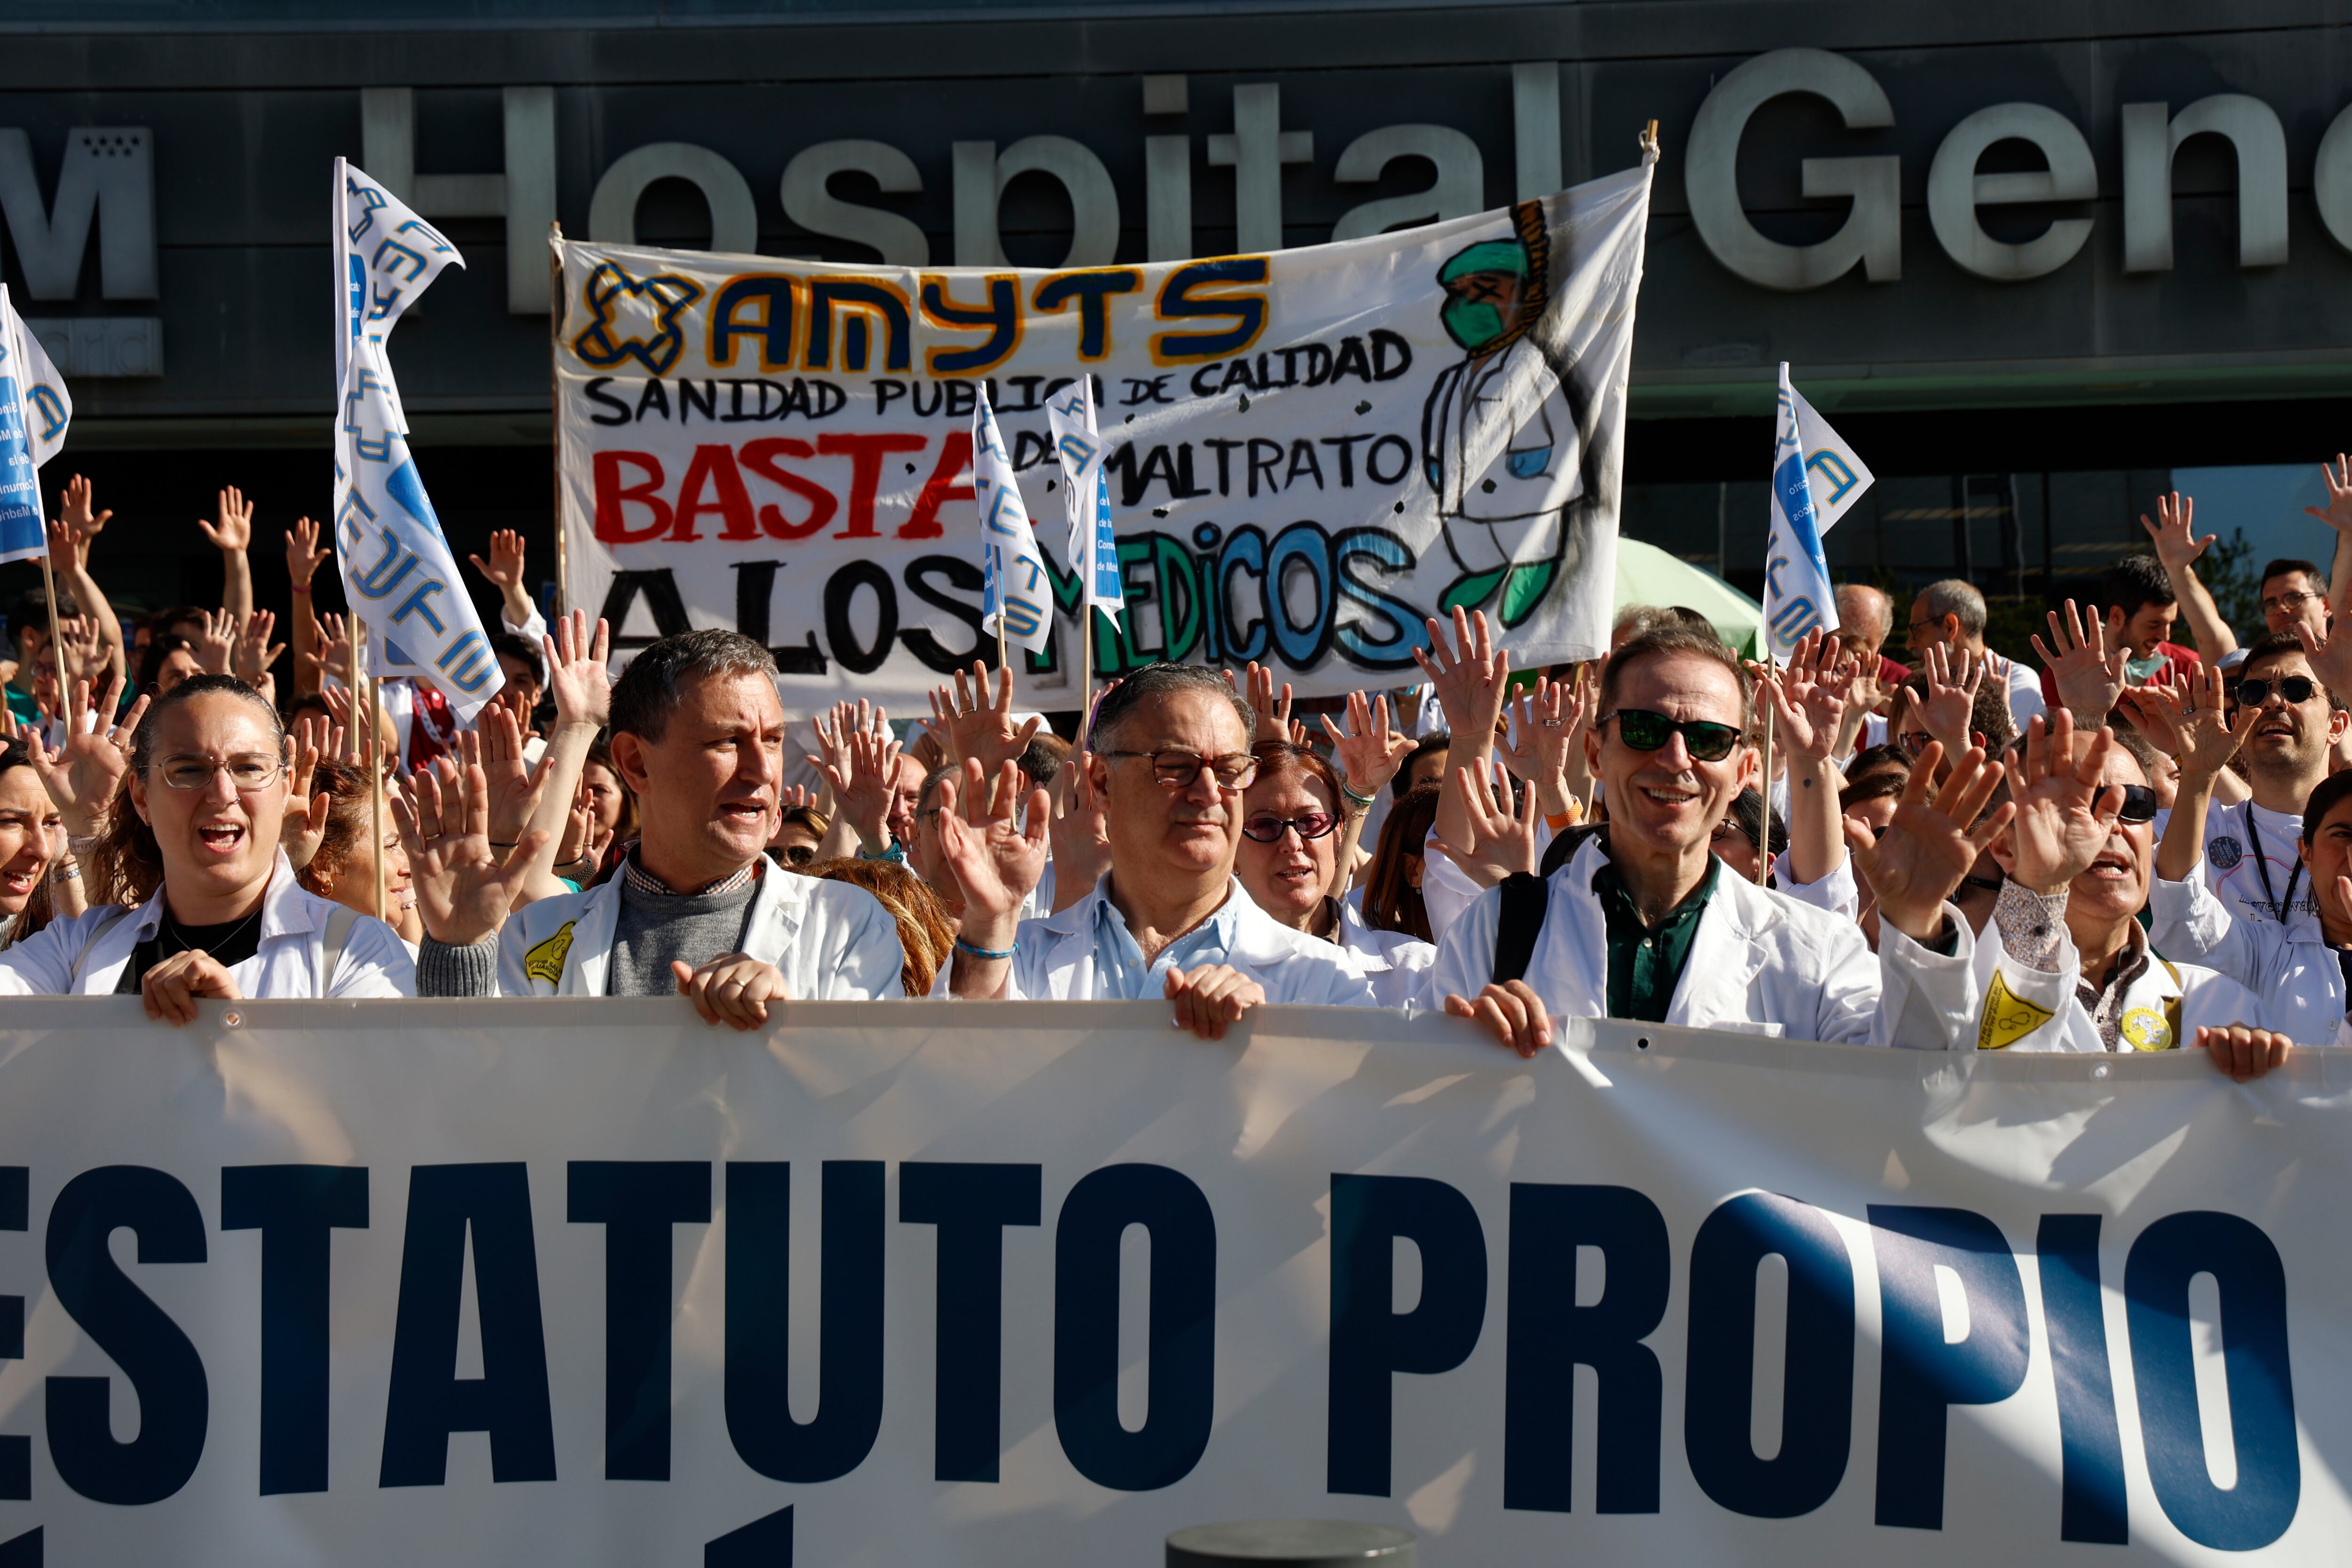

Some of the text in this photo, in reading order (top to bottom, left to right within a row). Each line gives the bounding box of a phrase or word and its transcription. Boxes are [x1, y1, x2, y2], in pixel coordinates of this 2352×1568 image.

[361, 47, 2352, 314] Hospital Gen
[585, 376, 847, 426] SANIDAD
[1120, 374, 1176, 406] DE
[1190, 328, 1413, 397] CALIDAD
[706, 255, 1271, 377] AMYTS
[1103, 433, 1414, 506] MALTRATO
[730, 554, 1001, 676] LOS
[0, 1159, 2302, 1552] STATUTO PROPIO
